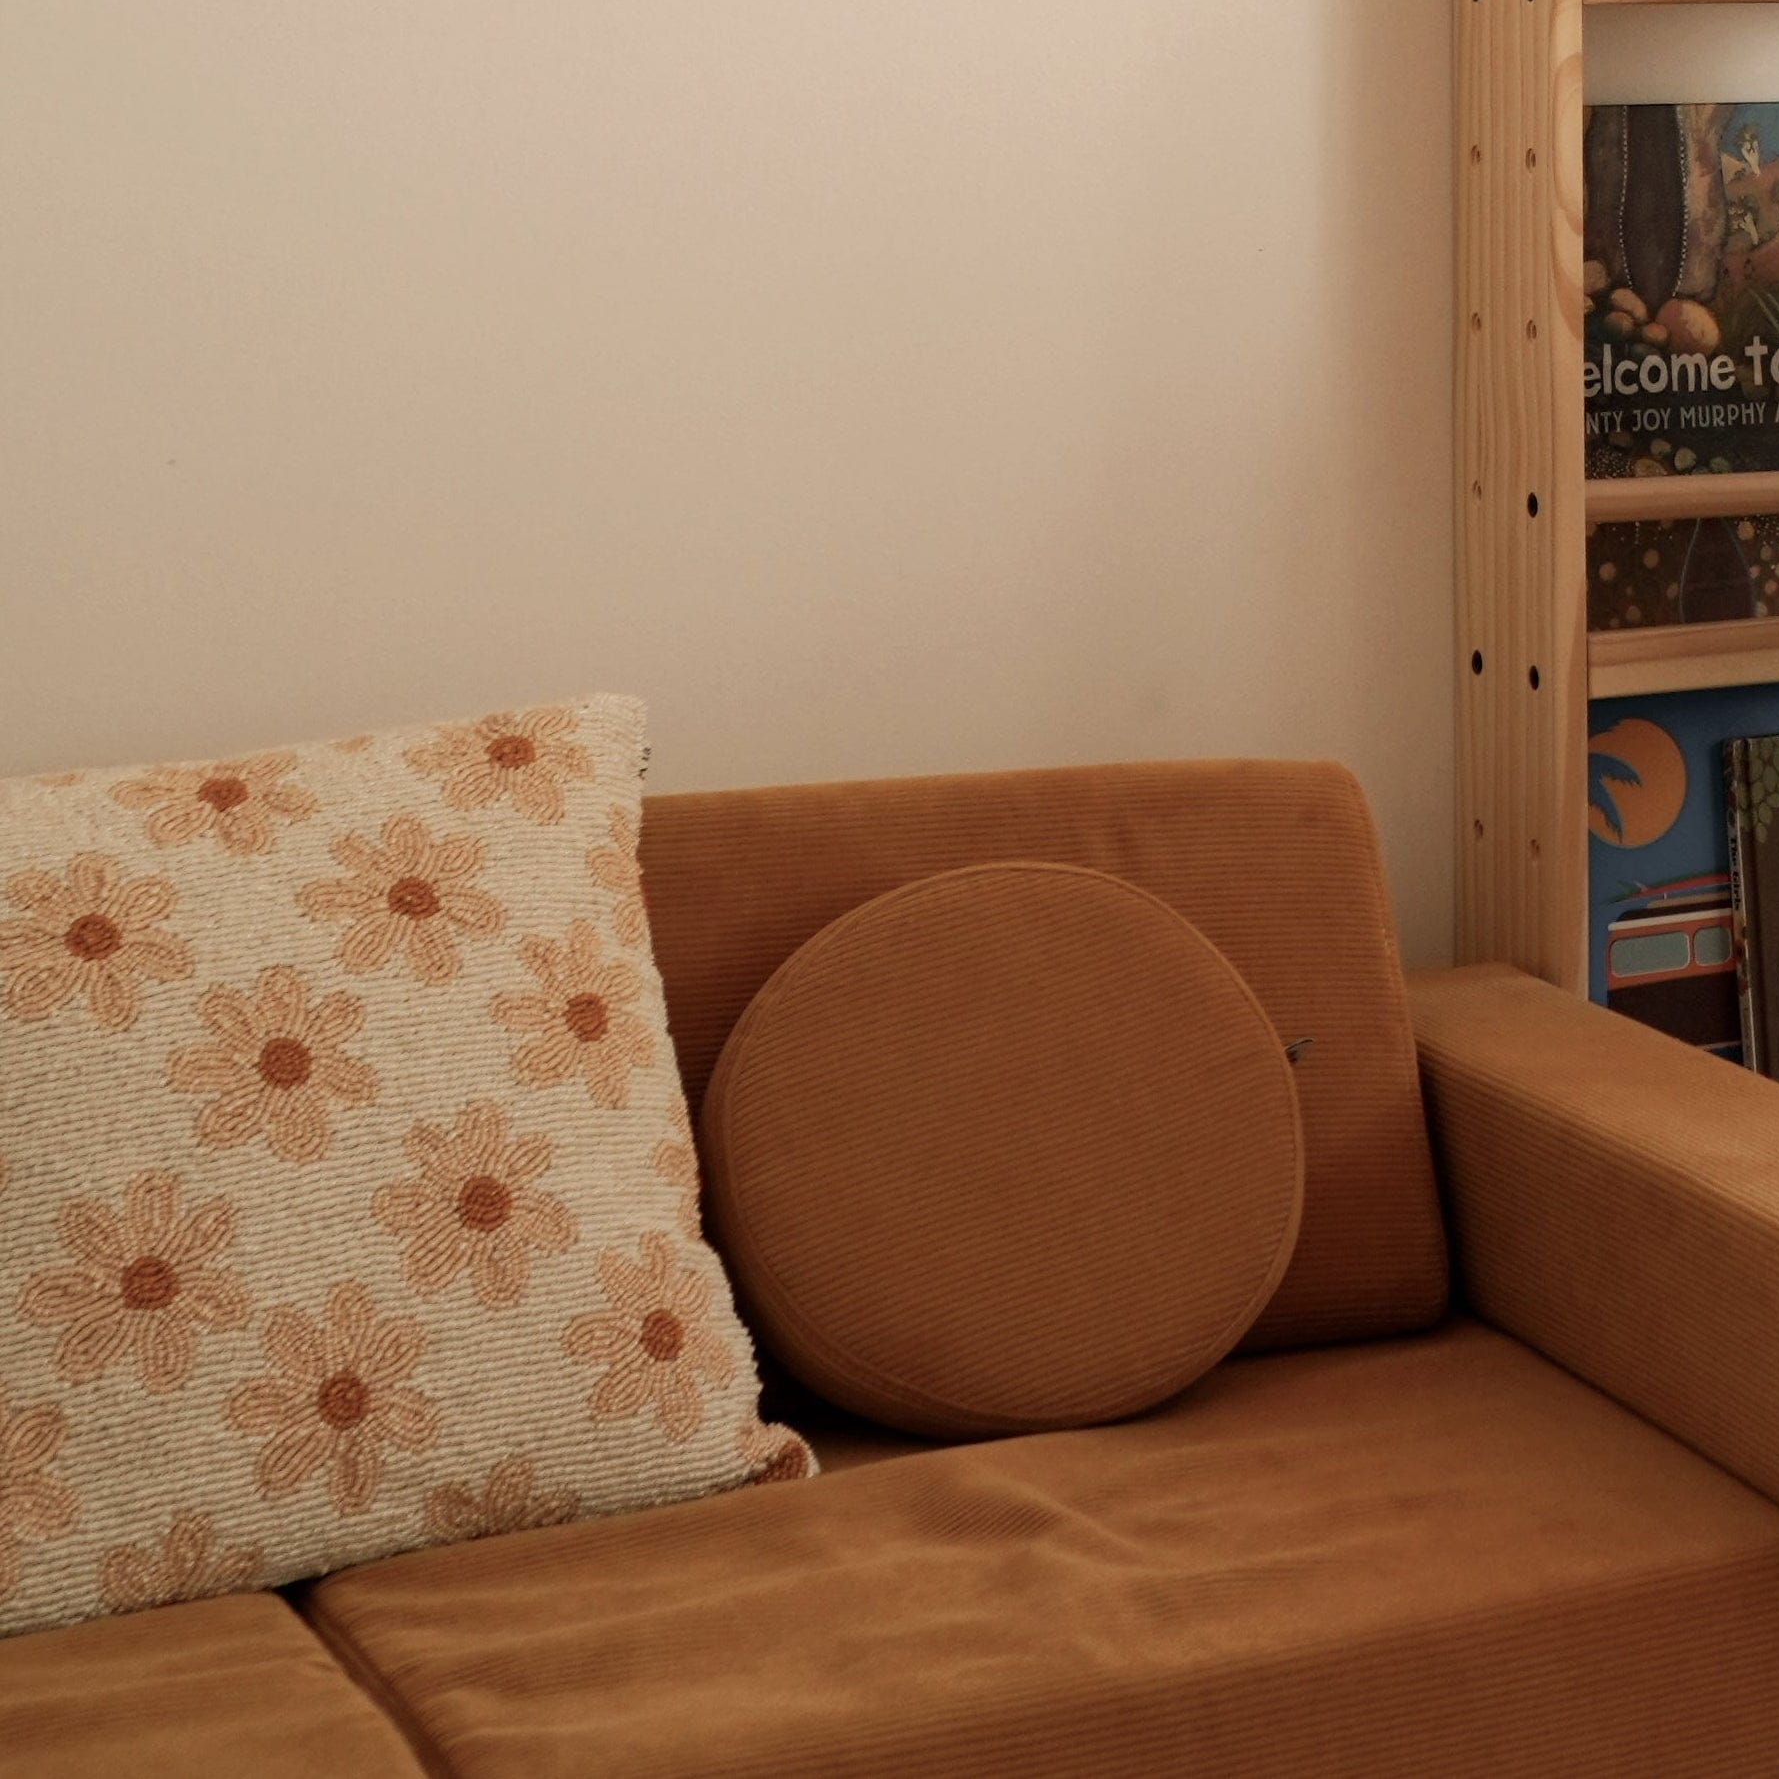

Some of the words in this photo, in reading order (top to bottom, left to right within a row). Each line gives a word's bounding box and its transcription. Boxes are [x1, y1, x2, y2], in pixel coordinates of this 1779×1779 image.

[1584, 343, 1736, 398] elcome
[1585, 410, 1624, 435] NTY
[1632, 407, 1672, 432] JOY
[1680, 402, 1767, 429] MURPHY
